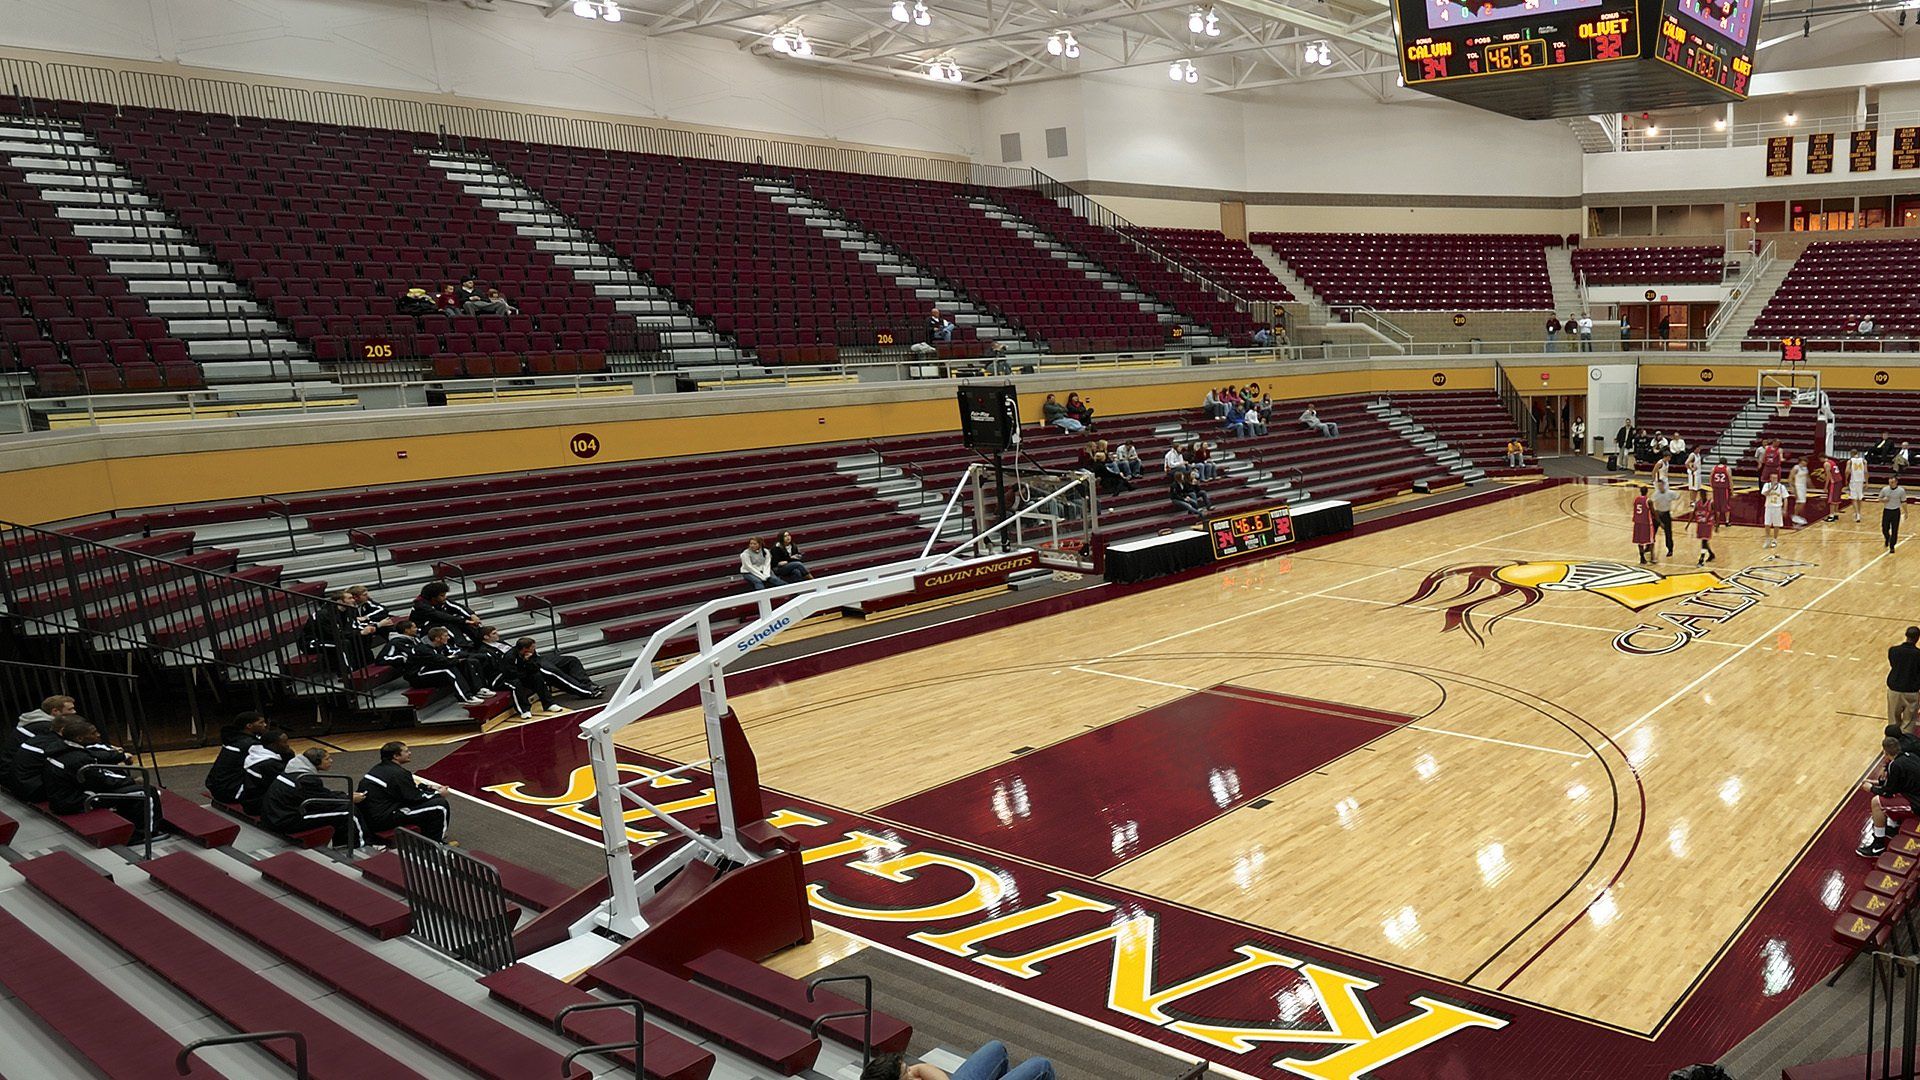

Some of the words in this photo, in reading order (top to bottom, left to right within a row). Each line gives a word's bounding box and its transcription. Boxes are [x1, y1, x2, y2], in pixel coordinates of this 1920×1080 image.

[1601, 12, 1619, 20] BONUS
[1579, 18, 1629, 38] OLIVET
[1408, 42, 1452, 60] CALVIN
[1595, 34, 1620, 60] 32
[1488, 44, 1532, 69] 46.6
[1422, 57, 1447, 80] 34
[877, 334, 893, 344] 206
[365, 344, 392, 358] 205
[1433, 375, 1445, 383] 107
[1875, 374, 1888, 382] 109
[573, 439, 597, 453] 104
[1714, 473, 1726, 482] 52
[1636, 504, 1643, 514] 5
[1235, 515, 1263, 533] 46.6
[1275, 517, 1290, 535] 32
[1217, 530, 1234, 549] 34
[924, 569, 972, 587] CALVIN
[975, 556, 1033, 576] KNIGHTS
[1612, 555, 1819, 656] CALVIN
[737, 617, 790, 652] Schelde
